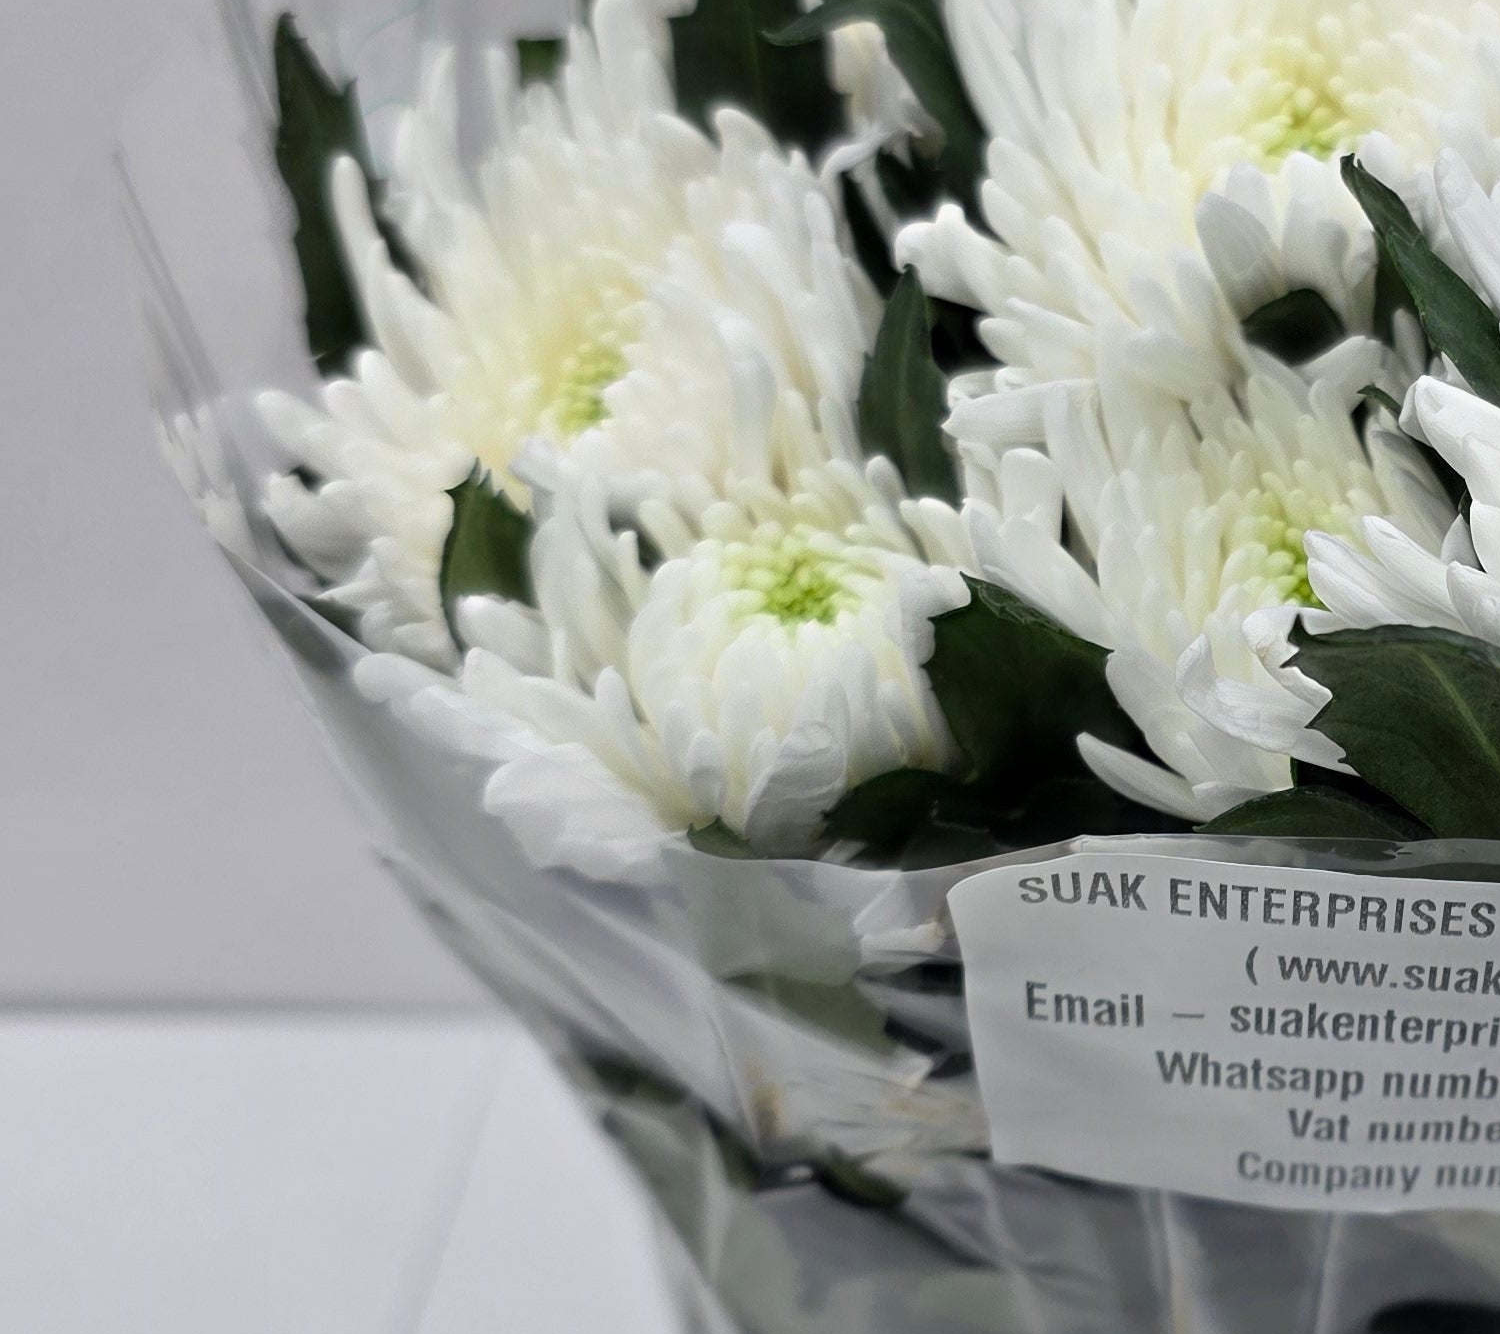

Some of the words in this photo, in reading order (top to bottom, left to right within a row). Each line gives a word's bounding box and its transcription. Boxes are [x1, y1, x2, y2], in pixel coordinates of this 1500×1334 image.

[1018, 872, 1148, 911] SUAK
[1169, 878, 1497, 939] ENTERPRISES
[1025, 980, 1145, 1028] Email
[1155, 1050, 1365, 1101] Whatsapp
[1287, 1108, 1350, 1143] Vat
[1237, 1151, 1422, 1195] Company
